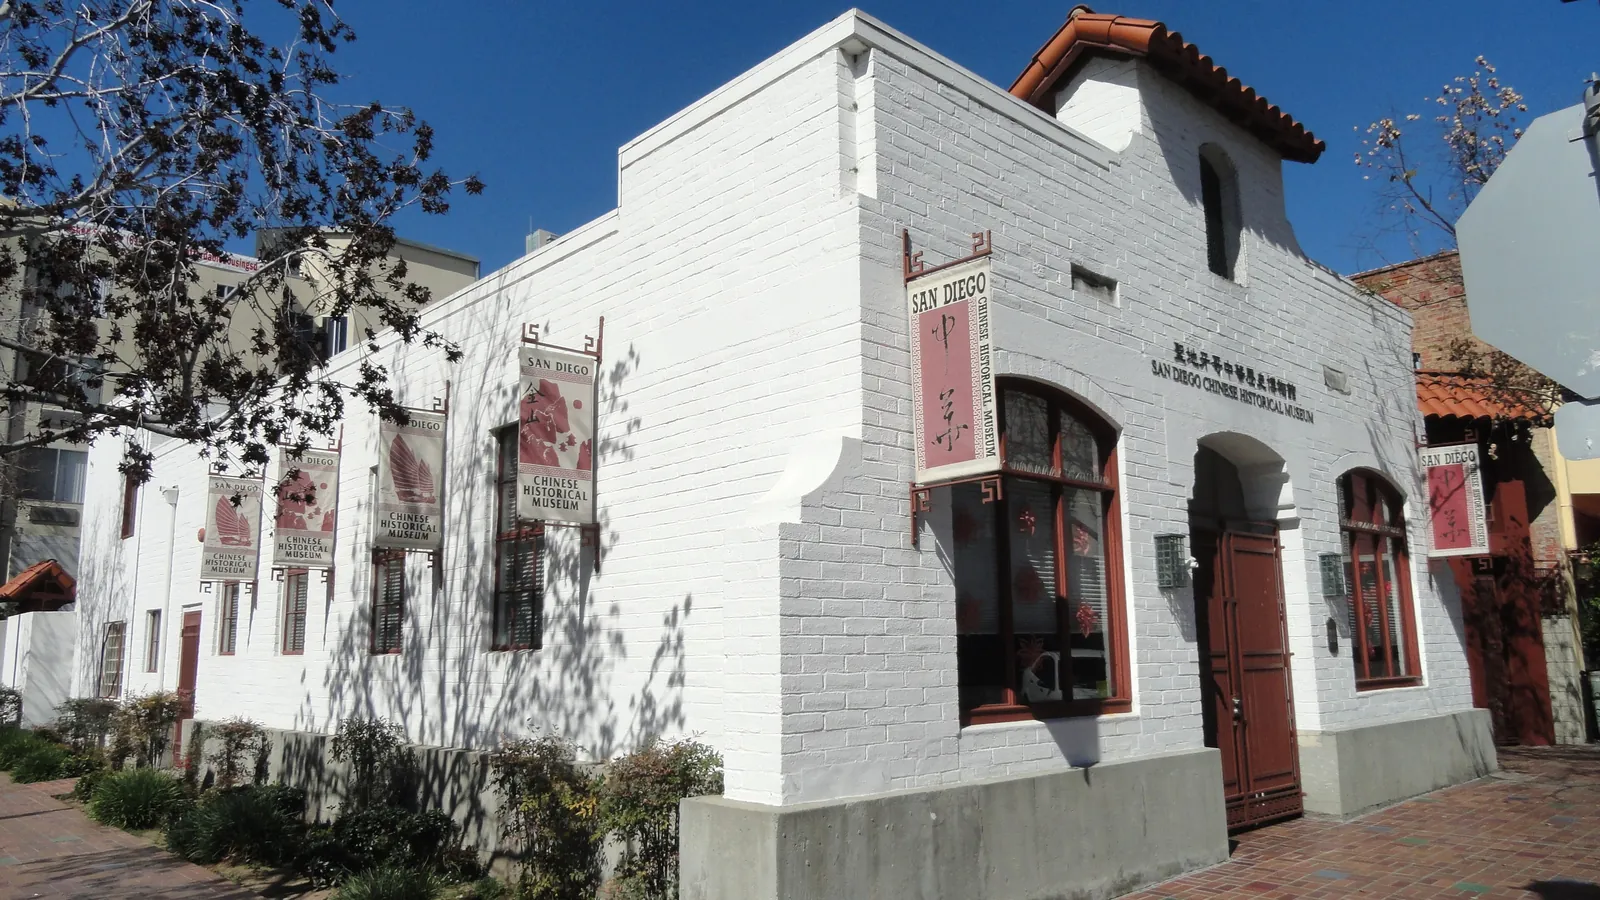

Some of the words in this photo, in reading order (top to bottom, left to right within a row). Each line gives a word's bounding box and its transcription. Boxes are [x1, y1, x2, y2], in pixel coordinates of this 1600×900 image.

[912, 287, 938, 315] SAN
[943, 271, 987, 305] DIEGO
[977, 296, 989, 342] CHINESE
[528, 357, 551, 370] SAN
[556, 363, 589, 376] DIEGO
[979, 342, 993, 407] HISTORICAL
[1151, 359, 1171, 380] SAN
[1172, 366, 1201, 390] DIEGO
[1203, 376, 1238, 400] CHINESE
[1239, 387, 1284, 415] HISTORICAL
[1284, 403, 1315, 424] MUSEUM
[411, 419, 440, 431] DIEGO
[983, 408, 997, 458] MUSEUM
[307, 457, 334, 466] DIEGO
[1421, 454, 1441, 467] SAN
[1444, 450, 1476, 465] DIEGO
[215, 482, 231, 490] SAN
[533, 475, 579, 490] CHINESE
[523, 485, 588, 501] HISTORICAL
[531, 497, 579, 511] MUSEUM
[1473, 489, 1484, 522] HISTORICAL
[389, 511, 430, 524] CHINESE
[380, 519, 437, 533] HISTORICAL
[286, 535, 322, 545] CHINESE
[387, 529, 429, 541] MUSEUM
[1476, 522, 1487, 548] MUSEUM
[278, 542, 329, 553] HISTORICAL
[213, 552, 246, 562] CHINESE
[285, 550, 322, 560] MUSEUM
[205, 559, 252, 569] HISTORICAL
[210, 566, 245, 574] MUSEUM
